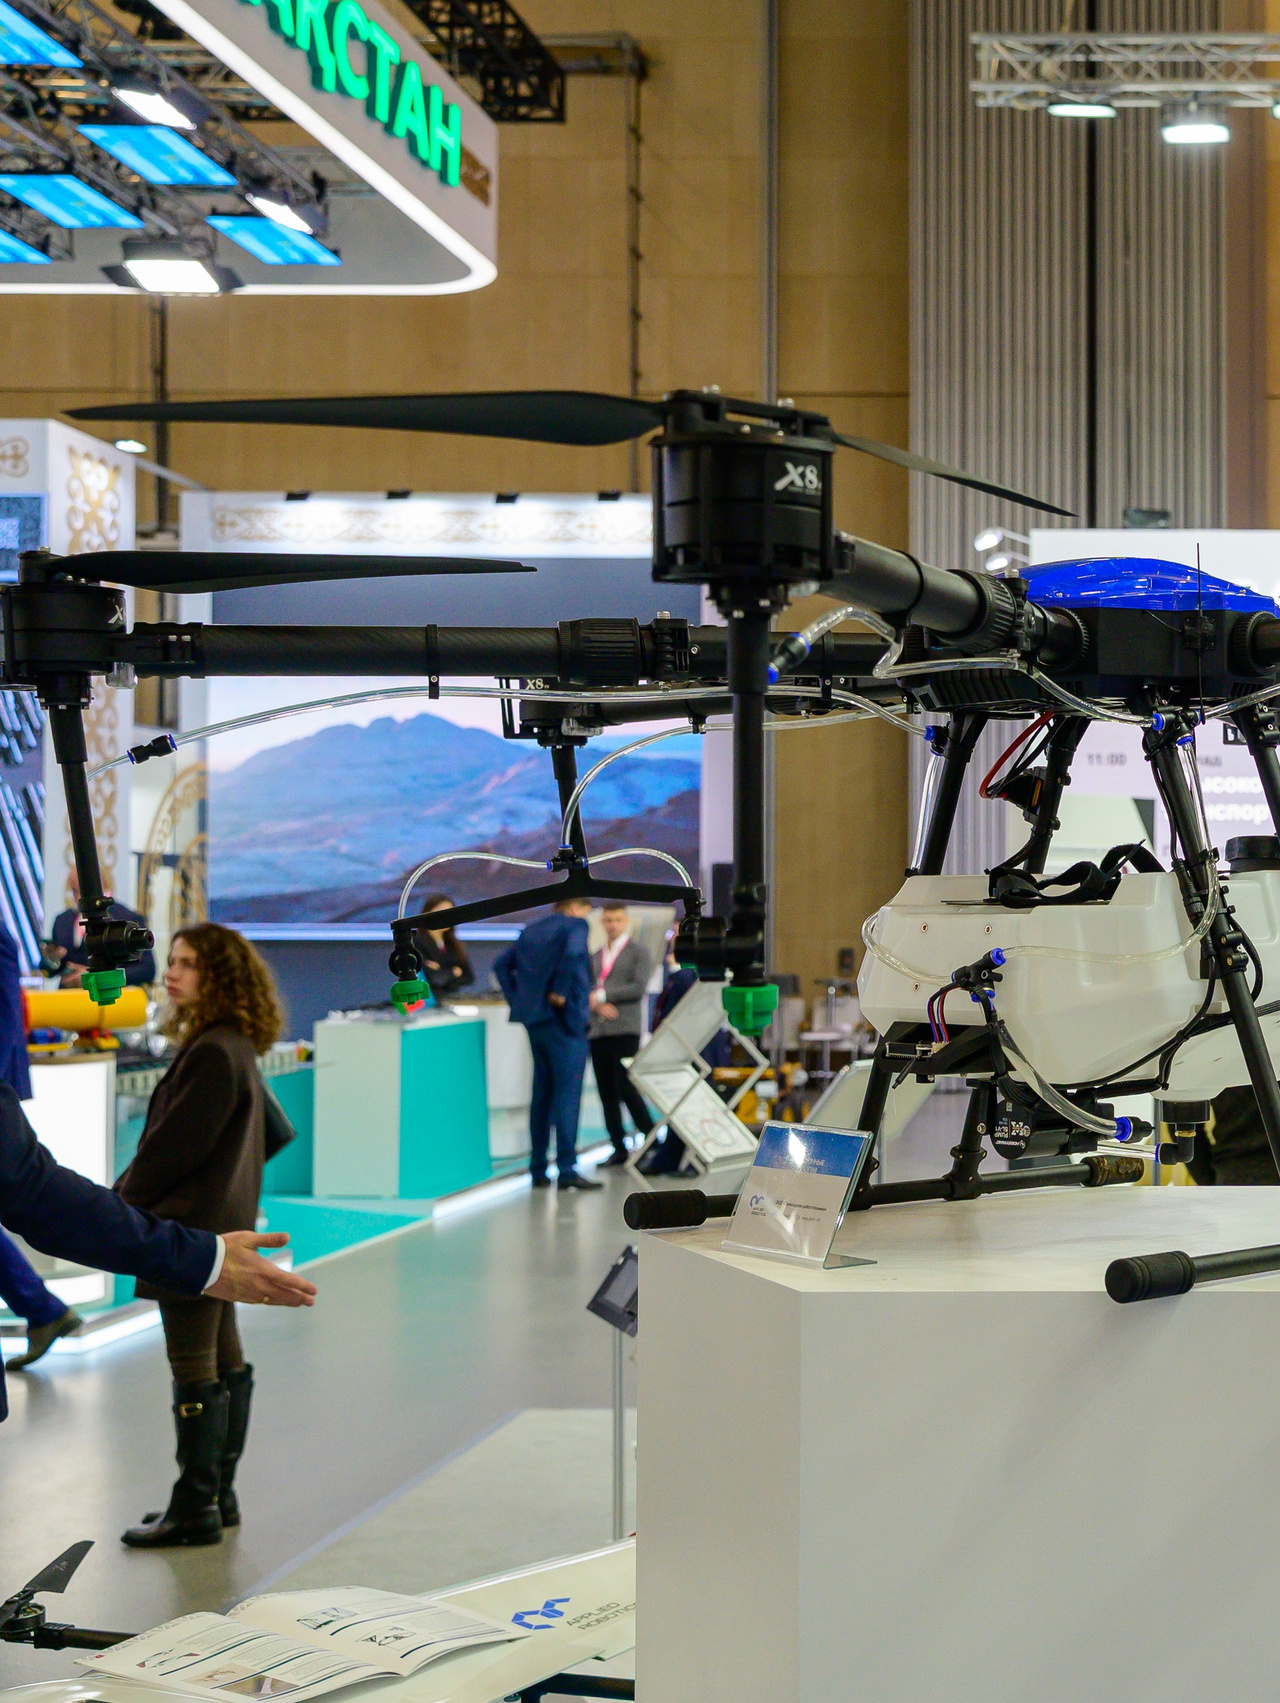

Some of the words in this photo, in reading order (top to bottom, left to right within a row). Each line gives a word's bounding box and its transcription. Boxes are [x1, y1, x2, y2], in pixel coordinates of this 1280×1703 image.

[774, 461, 819, 491] X8
[525, 678, 544, 690] X8
[566, 1602, 620, 1626] APPLIED
[578, 1603, 636, 1630] ROBOTIC
